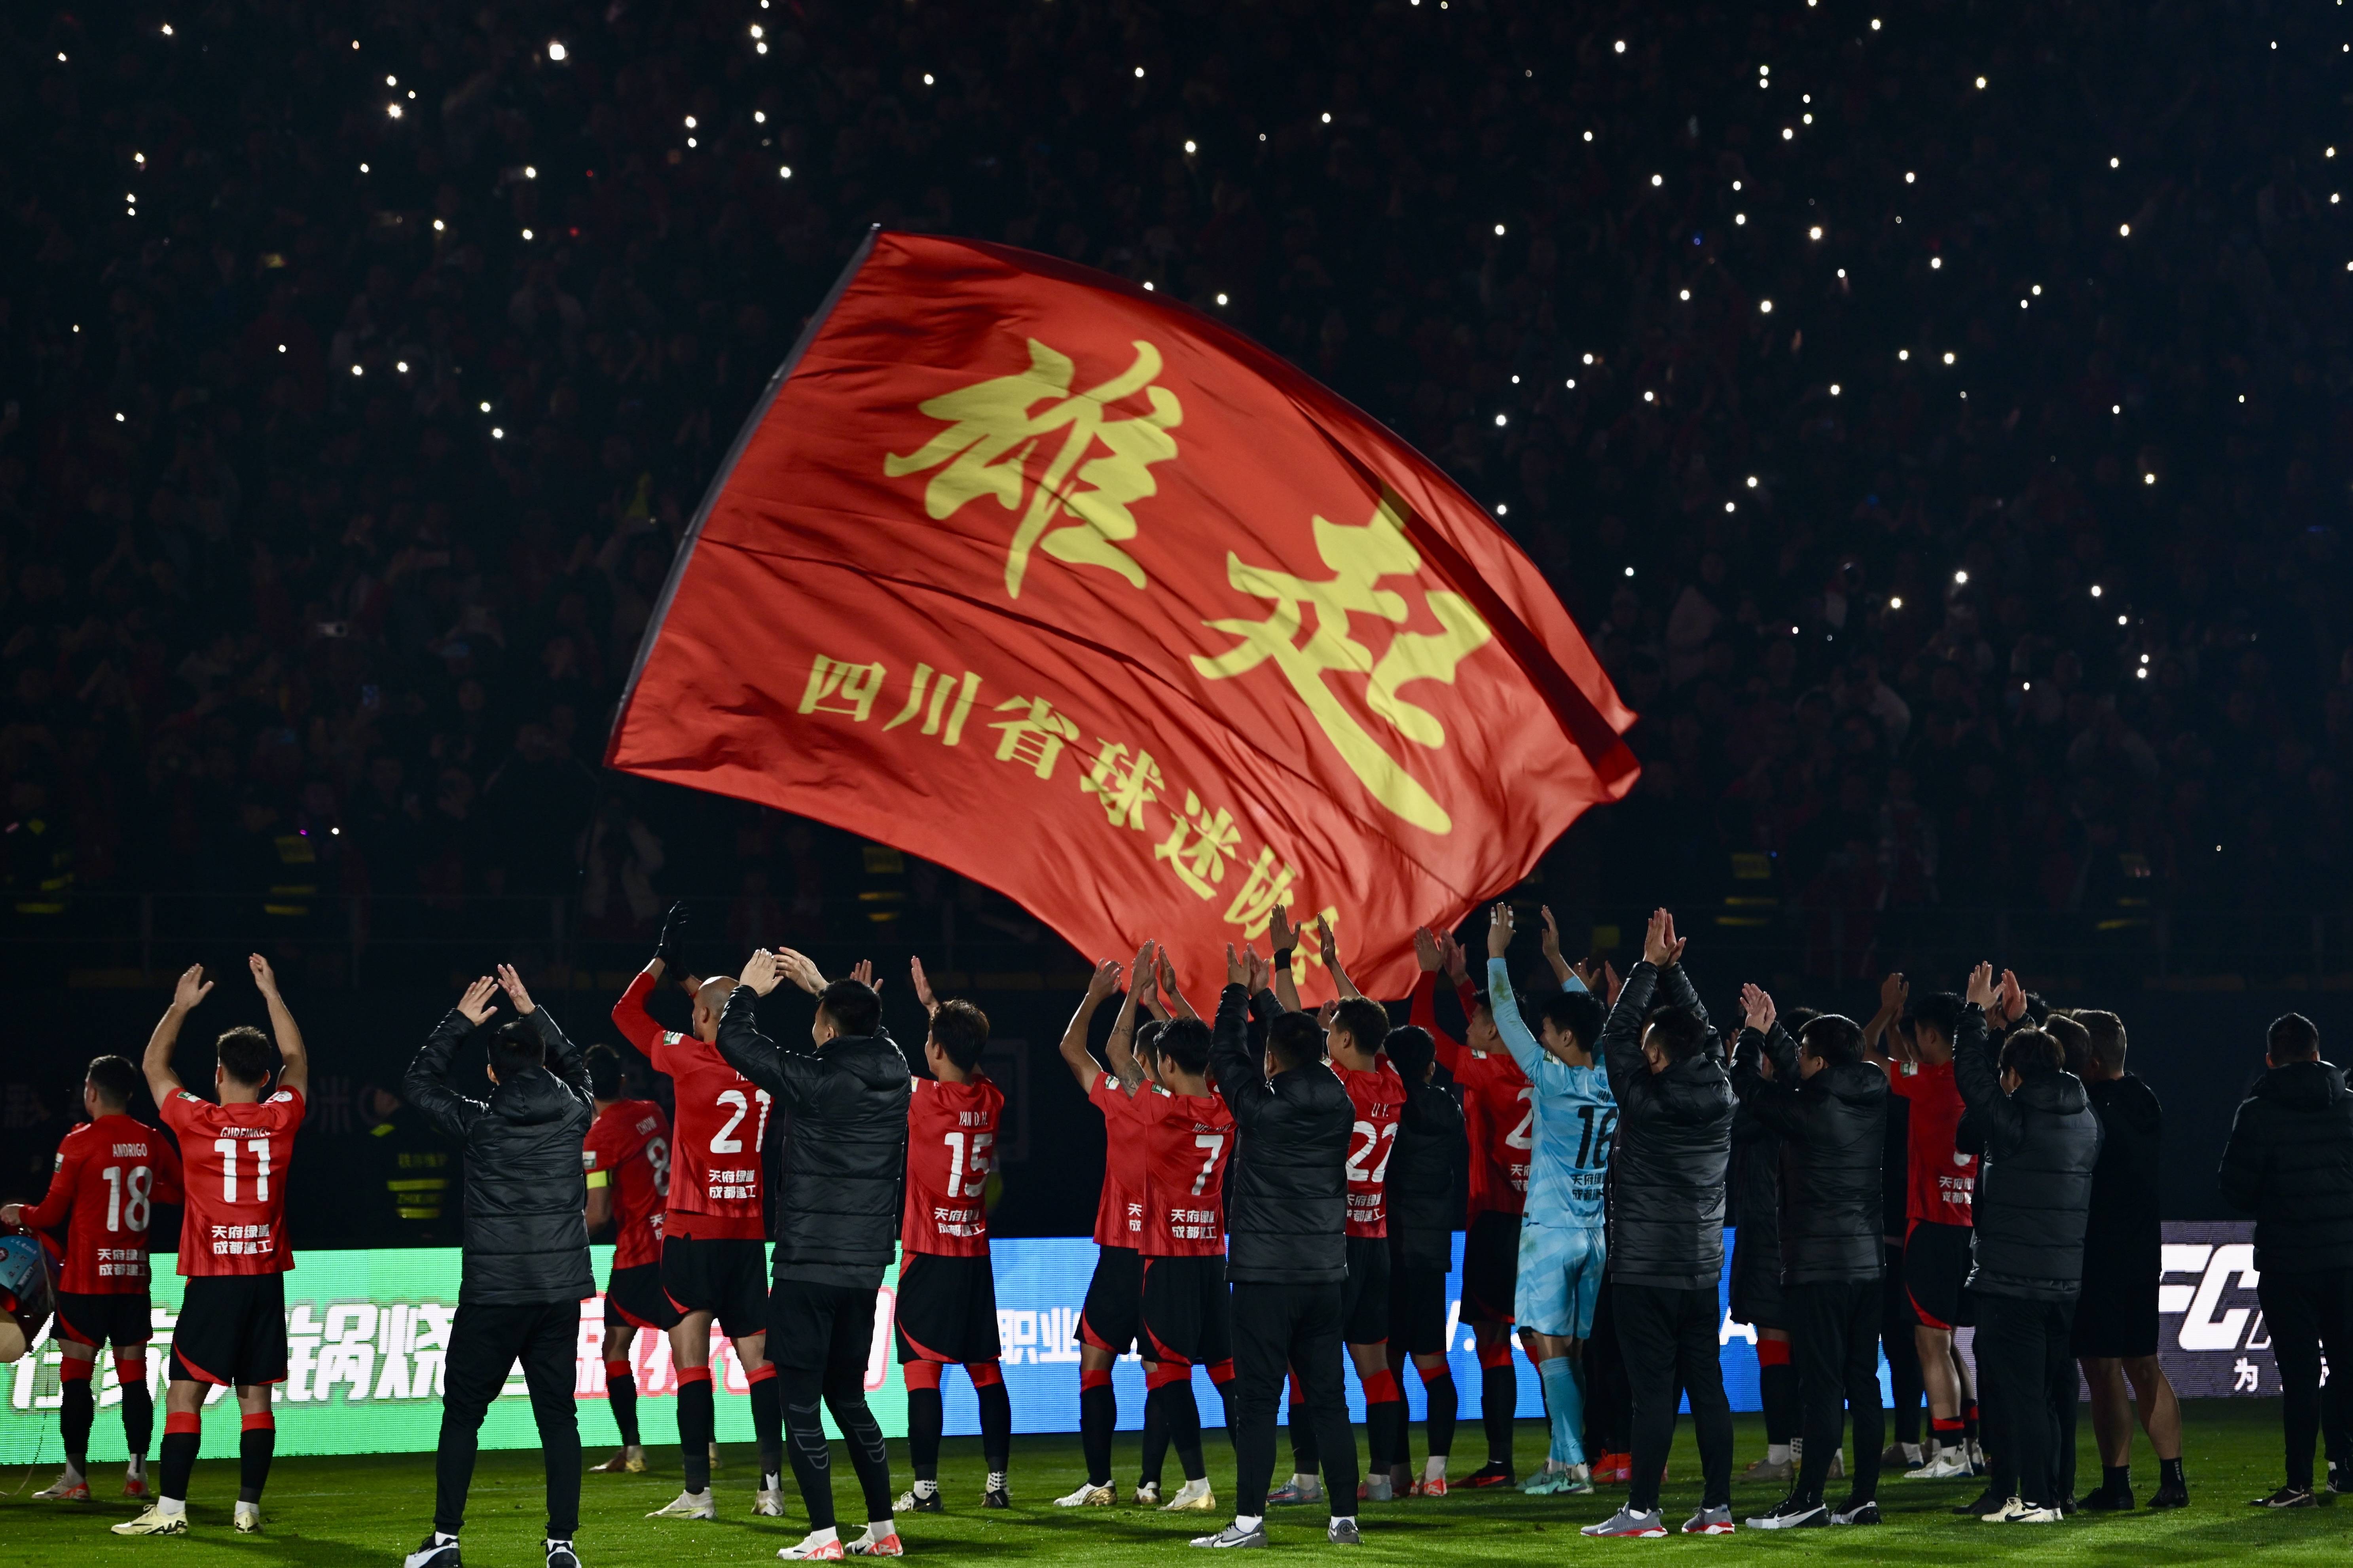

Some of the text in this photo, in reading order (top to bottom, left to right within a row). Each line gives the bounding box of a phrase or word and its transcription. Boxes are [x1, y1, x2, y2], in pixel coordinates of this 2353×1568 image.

[710, 1089, 771, 1154] 21
[959, 1111, 988, 1126] YAN D.H.
[1575, 1107, 1618, 1169] 16
[112, 1143, 148, 1157] ANDRIGO
[214, 1138, 271, 1203] 11
[646, 1136, 669, 1196] 8
[709, 1169, 755, 1183] 天府绿道
[944, 1132, 993, 1198] 15
[1191, 1134, 1224, 1196] 7
[102, 1166, 153, 1232] 18
[709, 1185, 756, 1199] 成都建工
[211, 1224, 270, 1239] 天府绿道
[213, 1240, 273, 1255] 成都建工
